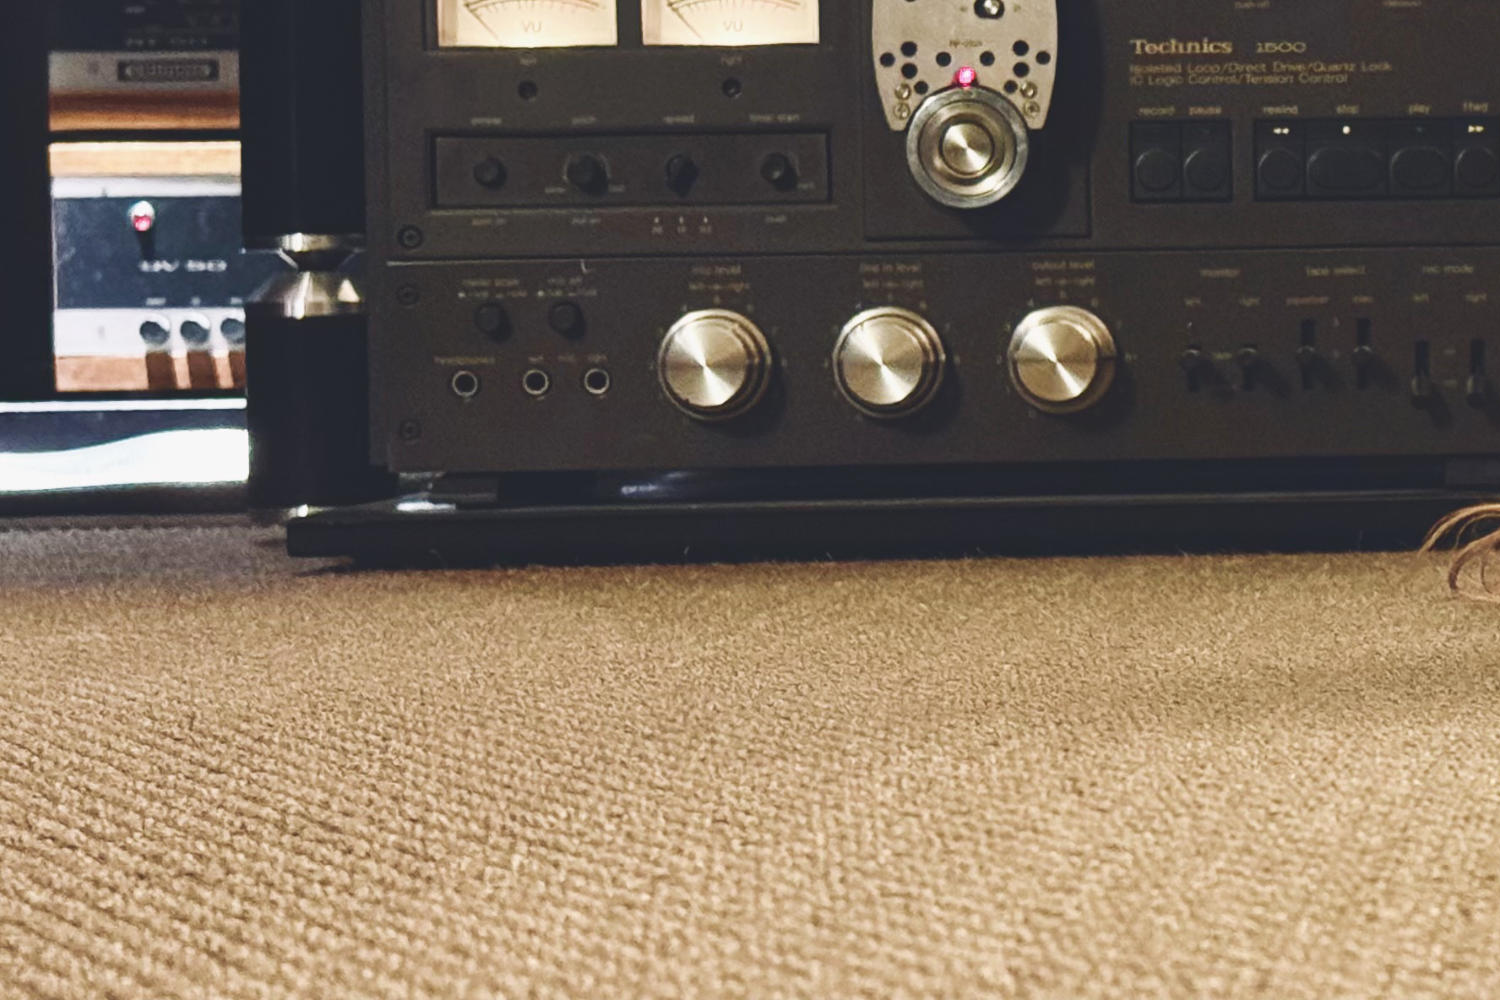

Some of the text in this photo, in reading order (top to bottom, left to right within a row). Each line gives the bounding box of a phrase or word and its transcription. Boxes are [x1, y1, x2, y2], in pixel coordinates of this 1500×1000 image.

[1130, 38, 1307, 55] Technics 1500
[1299, 72, 1349, 84] Control
